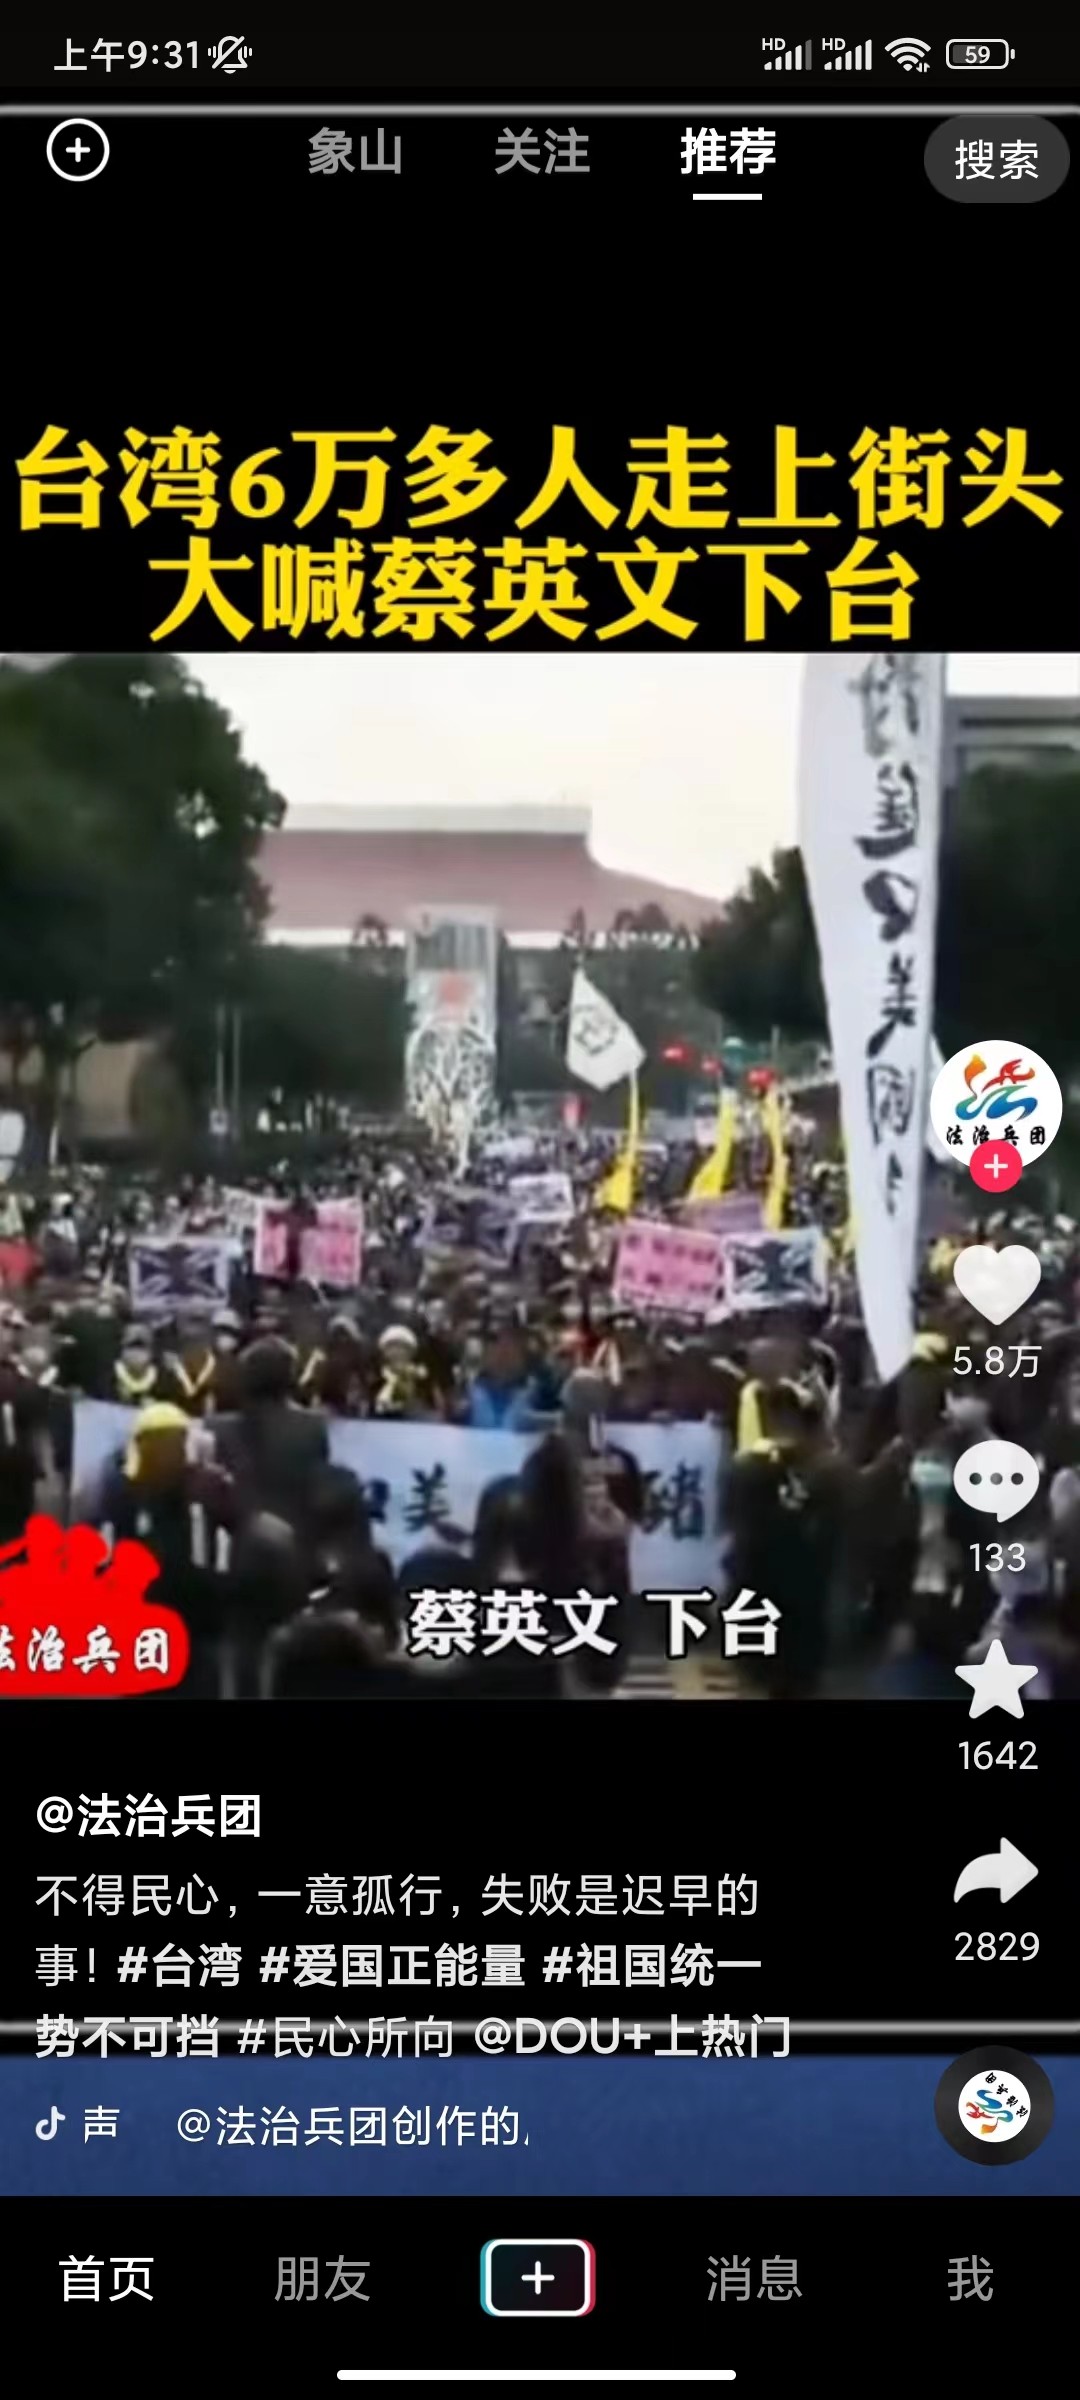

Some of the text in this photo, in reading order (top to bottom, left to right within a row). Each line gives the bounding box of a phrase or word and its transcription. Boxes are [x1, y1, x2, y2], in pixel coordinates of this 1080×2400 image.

[54, 38, 199, 72] 上午9:31
[761, 38, 786, 51] HD
[821, 38, 846, 51] HD
[964, 46, 991, 64] 59
[307, 127, 401, 176] 象山
[494, 127, 590, 175] 关注
[680, 127, 777, 175] 推荐
[954, 138, 1039, 181] 搜索
[952, 1345, 1042, 1378] 5.8万
[969, 1543, 1027, 1572] 133
[958, 1740, 1039, 1770] 1642
[36, 1792, 261, 1838] @法治兵团
[117, 1943, 243, 1988] #台湾
[259, 1943, 526, 1988] #爱国正能量
[542, 1943, 762, 1988] #祖国统一
[954, 1931, 1040, 1961] 2829
[35, 2013, 791, 2059] 势不可挡 #民心所向 @DOU+上热门
[177, 2105, 529, 2147] @法治兵团创作的
[58, 2254, 154, 2302] 首页
[274, 2254, 371, 2302] 朋友
[706, 2254, 803, 2302] 消息
[947, 2254, 994, 2302] 我
